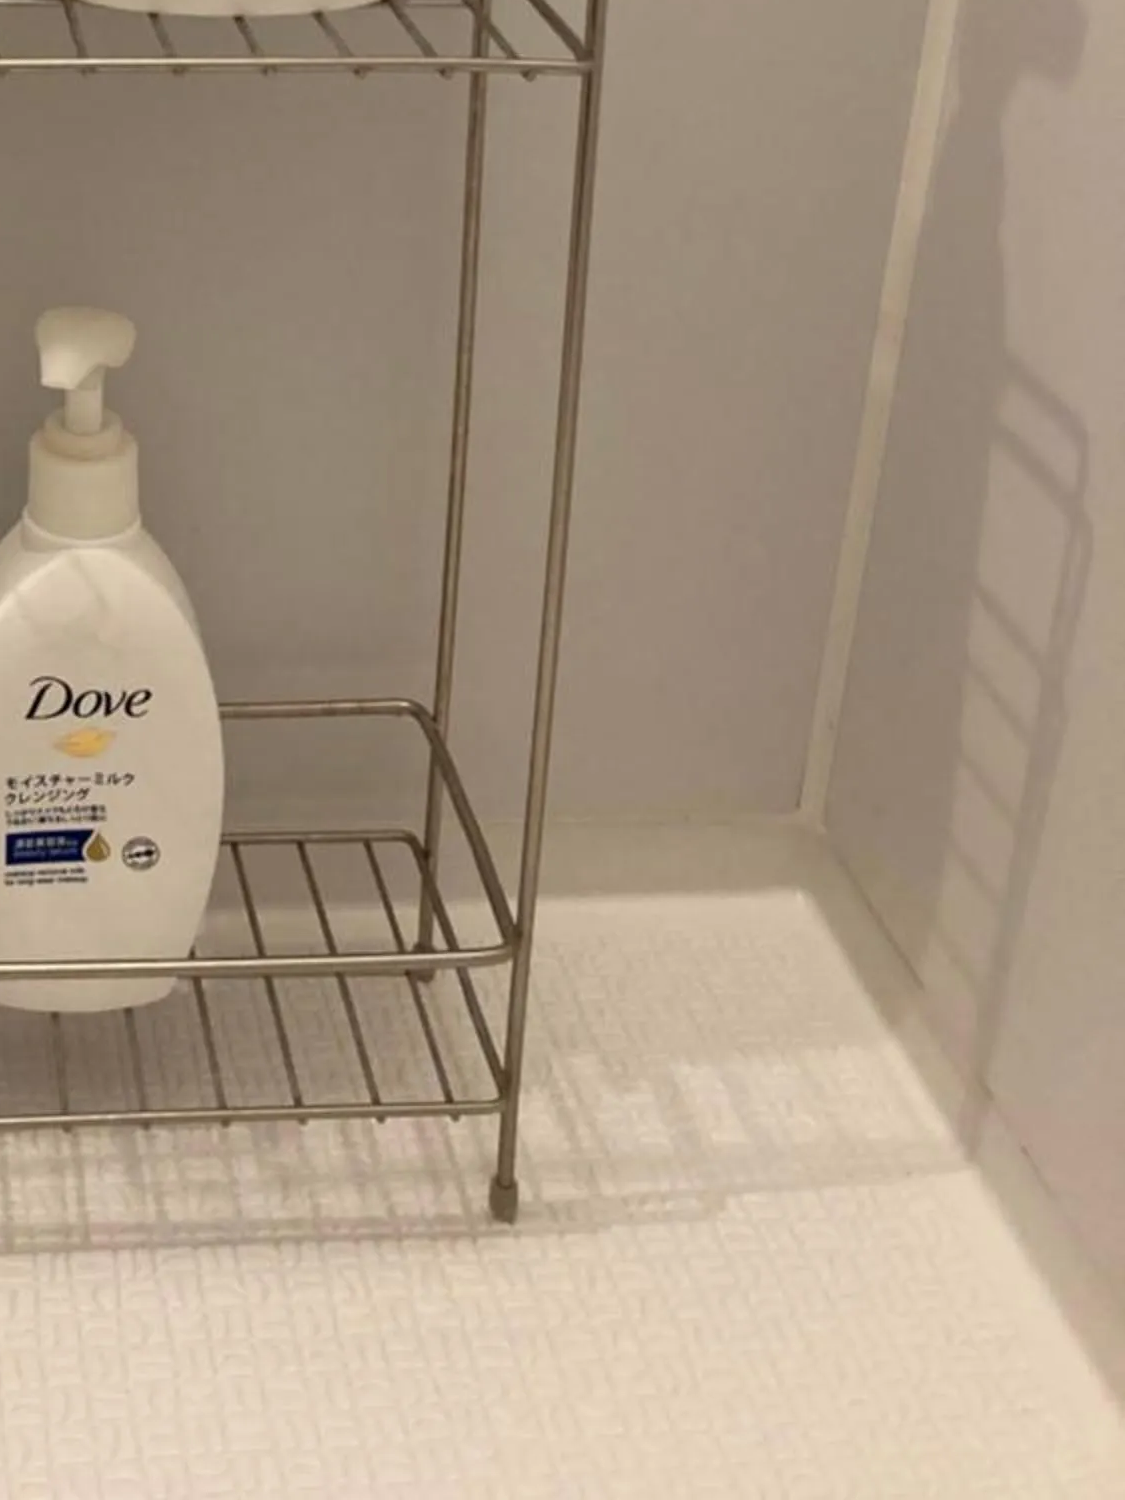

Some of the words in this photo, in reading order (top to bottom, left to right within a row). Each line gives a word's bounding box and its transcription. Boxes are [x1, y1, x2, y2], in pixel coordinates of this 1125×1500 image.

[25, 675, 153, 720] Dove
[6, 772, 136, 790] モイスチャーミルク
[4, 788, 91, 805] クレンジング
